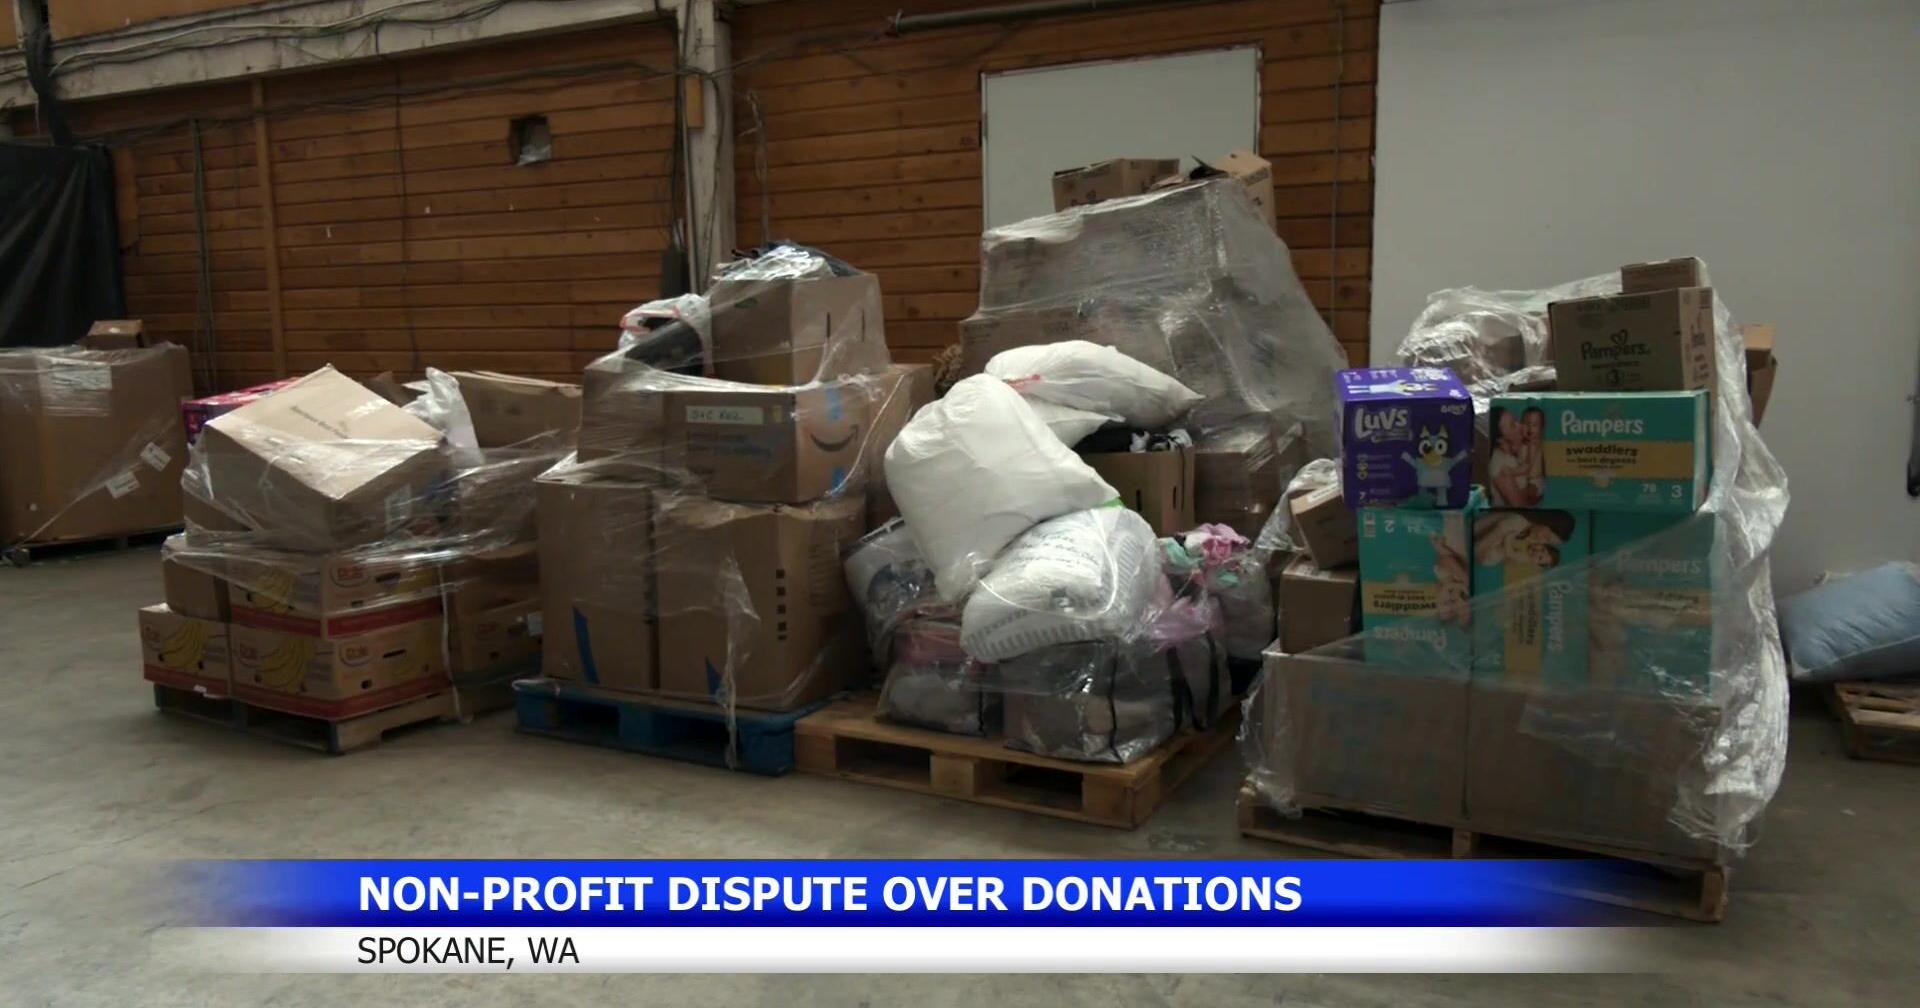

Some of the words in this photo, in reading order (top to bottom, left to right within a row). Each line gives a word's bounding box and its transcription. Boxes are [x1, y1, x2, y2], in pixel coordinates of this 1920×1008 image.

[1581, 340, 1647, 361] Pampers
[1561, 410, 1644, 437] Pampers
[1566, 444, 1638, 456] swaddlers
[1671, 484, 1683, 499] 3
[1384, 519, 1396, 534] 2
[1545, 579, 1573, 652] Pampers
[1373, 626, 1447, 652] Pampers
